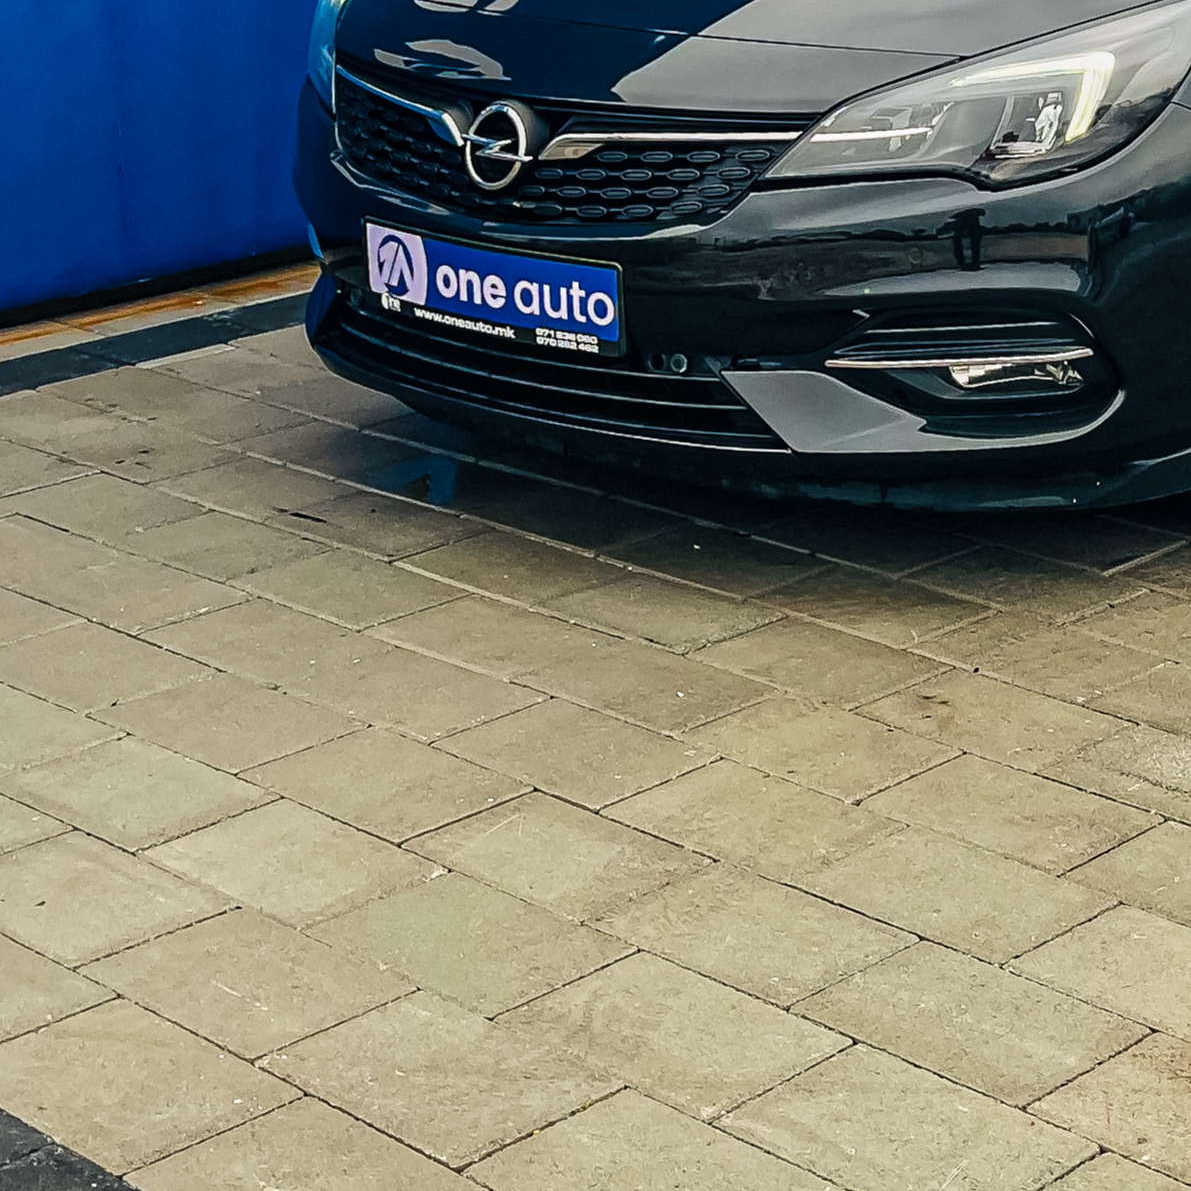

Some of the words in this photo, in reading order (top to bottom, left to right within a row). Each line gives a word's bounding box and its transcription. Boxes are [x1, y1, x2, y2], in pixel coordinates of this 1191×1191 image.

[436, 265, 507, 309] one
[514, 281, 615, 326] auto
[414, 307, 517, 339] www.oneauto.mk
